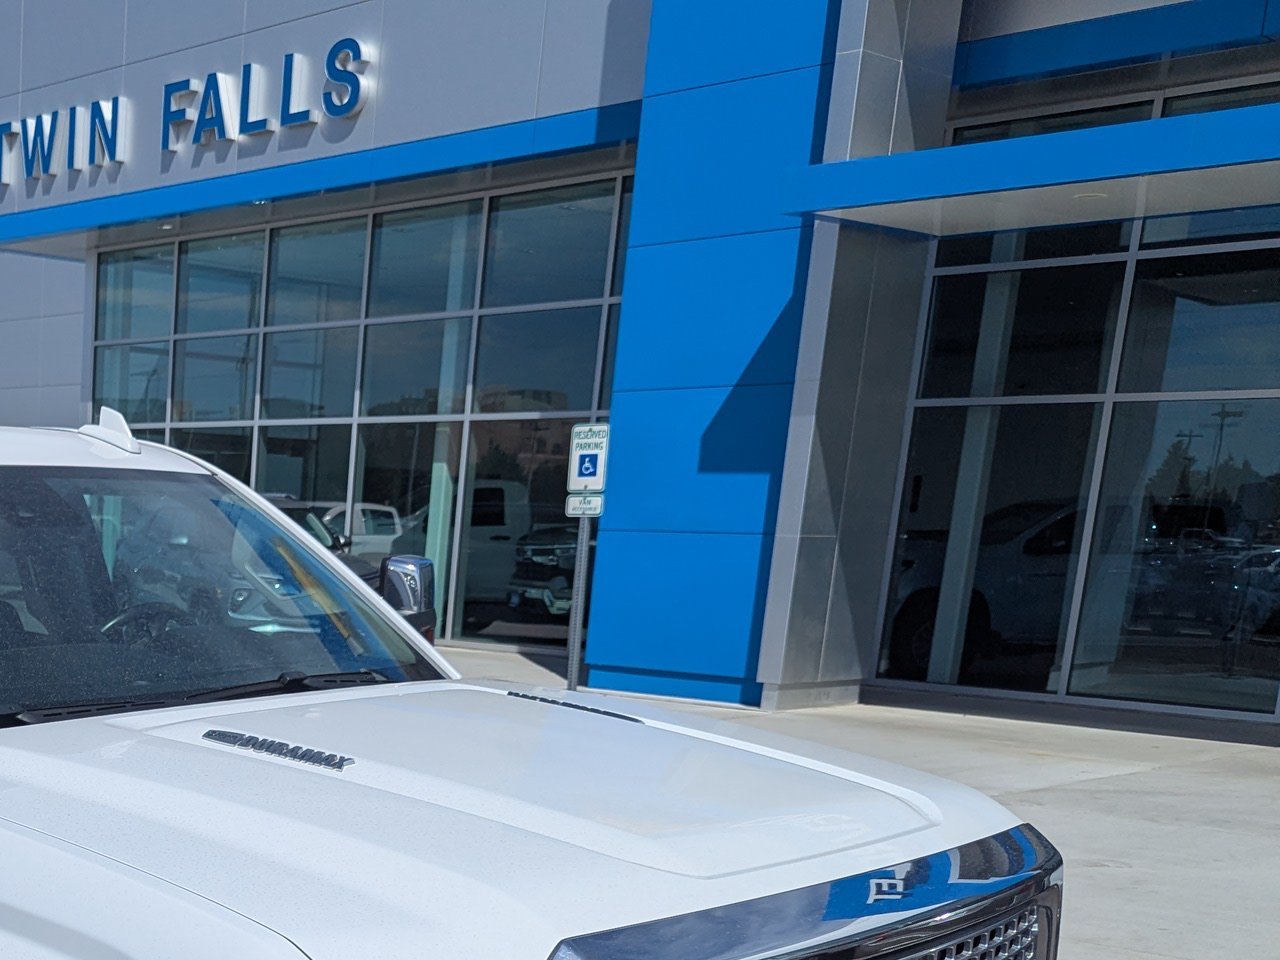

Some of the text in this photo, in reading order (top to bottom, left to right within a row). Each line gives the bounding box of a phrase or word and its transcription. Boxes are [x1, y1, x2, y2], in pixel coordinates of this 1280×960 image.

[161, 38, 370, 152] FALLS
[574, 430, 607, 440] RESERVED
[575, 442, 604, 451] PARKING
[237, 735, 356, 772] DURAMAX
